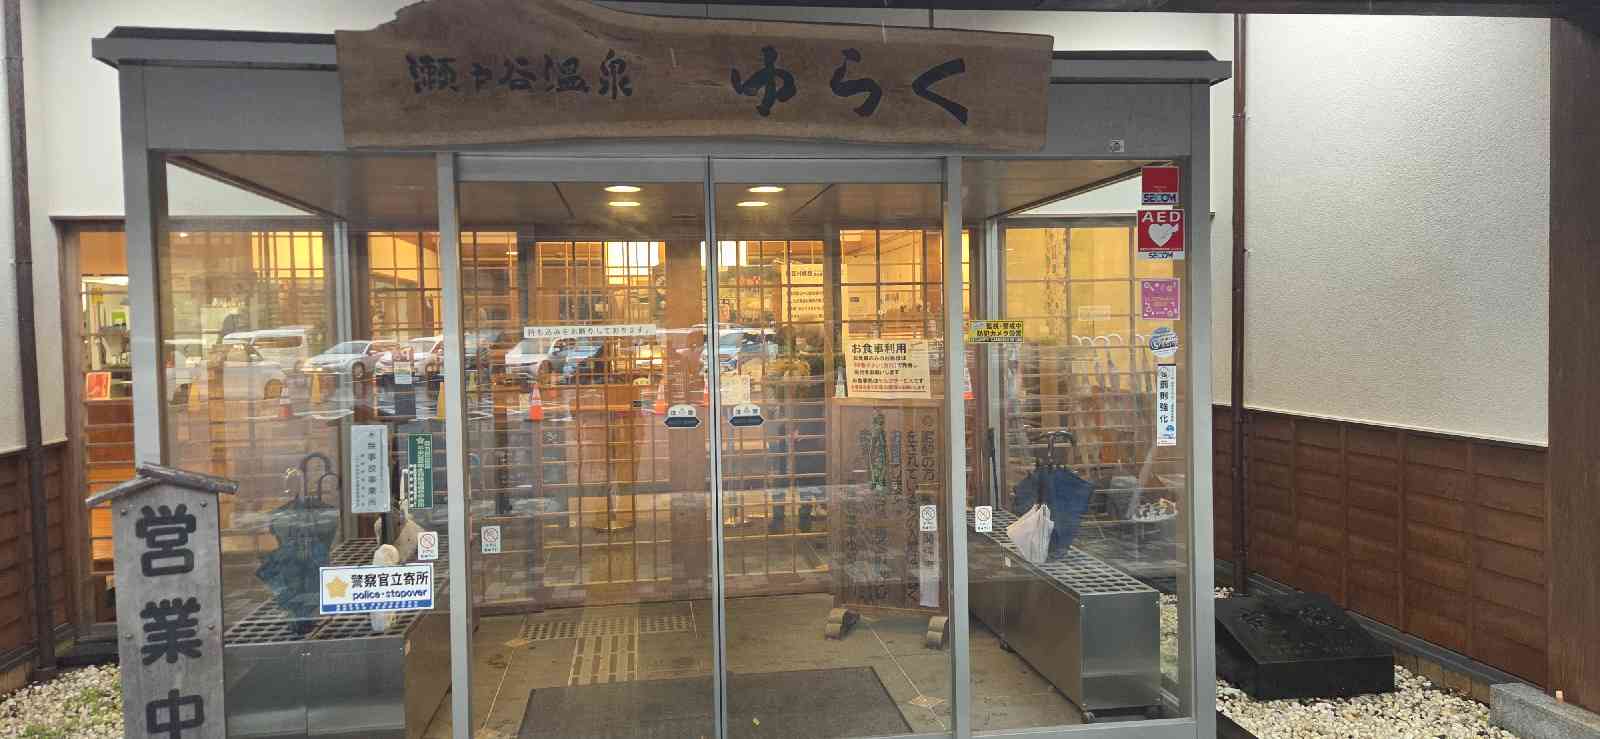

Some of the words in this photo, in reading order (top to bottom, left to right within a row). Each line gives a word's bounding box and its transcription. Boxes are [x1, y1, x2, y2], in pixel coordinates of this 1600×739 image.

[731, 45, 968, 126] ゆらく
[1142, 211, 1181, 223] AED
[851, 343, 907, 354] お食事利用
[351, 571, 429, 588] 警察官立寄所
[135, 503, 205, 739] 営業中
